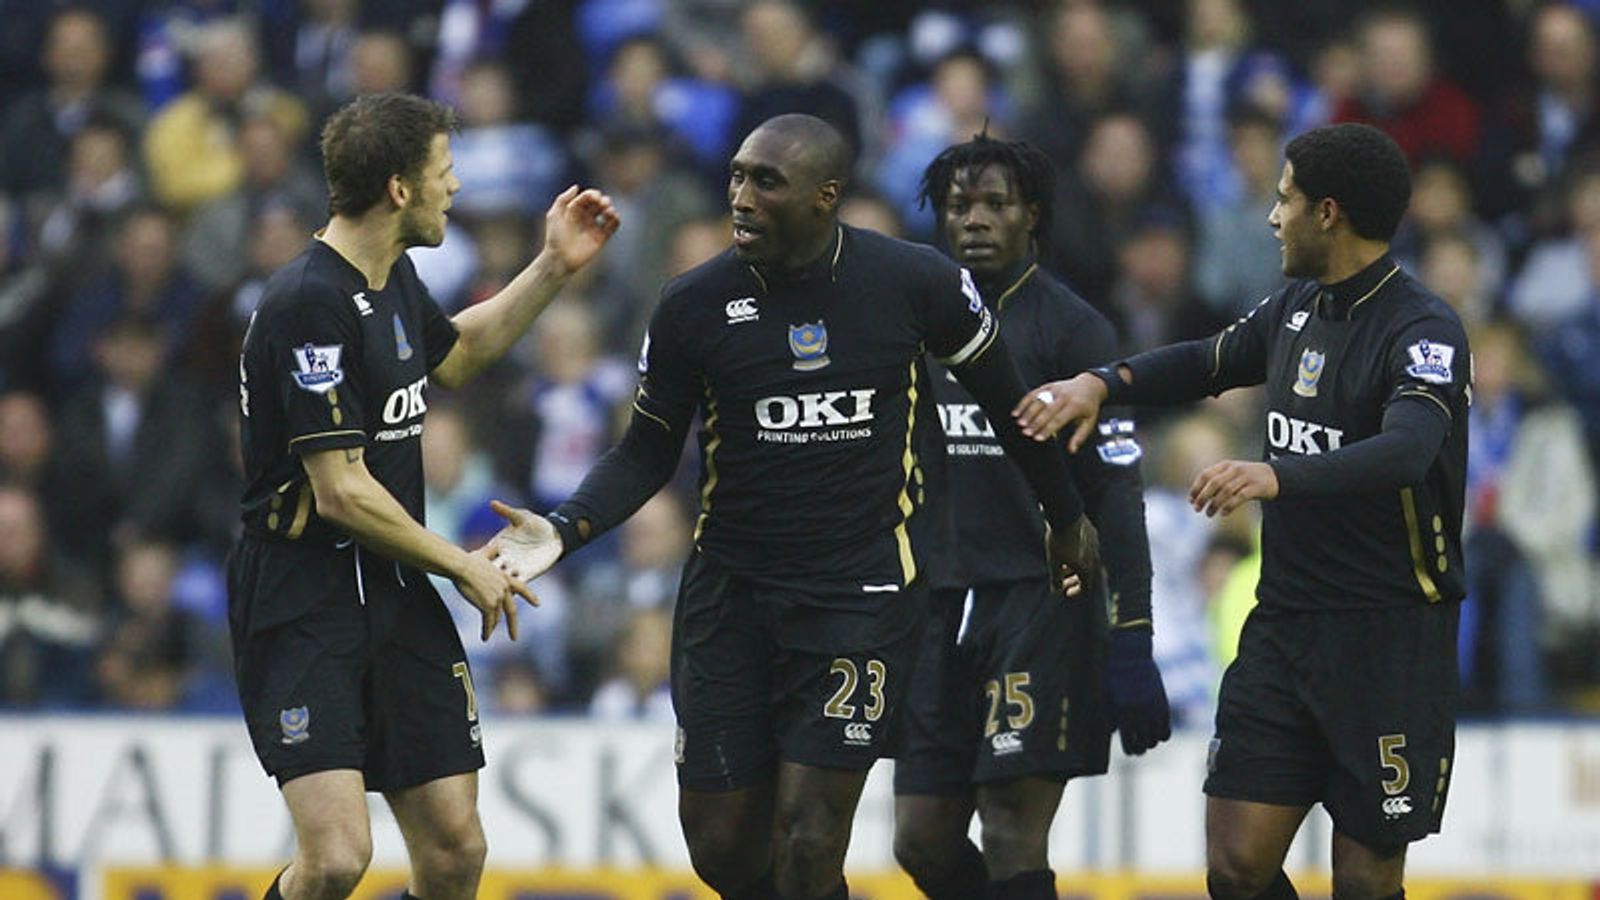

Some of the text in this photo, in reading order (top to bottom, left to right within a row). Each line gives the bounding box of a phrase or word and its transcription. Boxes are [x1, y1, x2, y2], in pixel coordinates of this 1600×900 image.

[383, 376, 427, 424] OK
[755, 388, 876, 429] OKI
[1268, 411, 1343, 455] OKI
[824, 658, 886, 721] 23
[984, 672, 1034, 738] 25
[1378, 734, 1410, 795] 5
